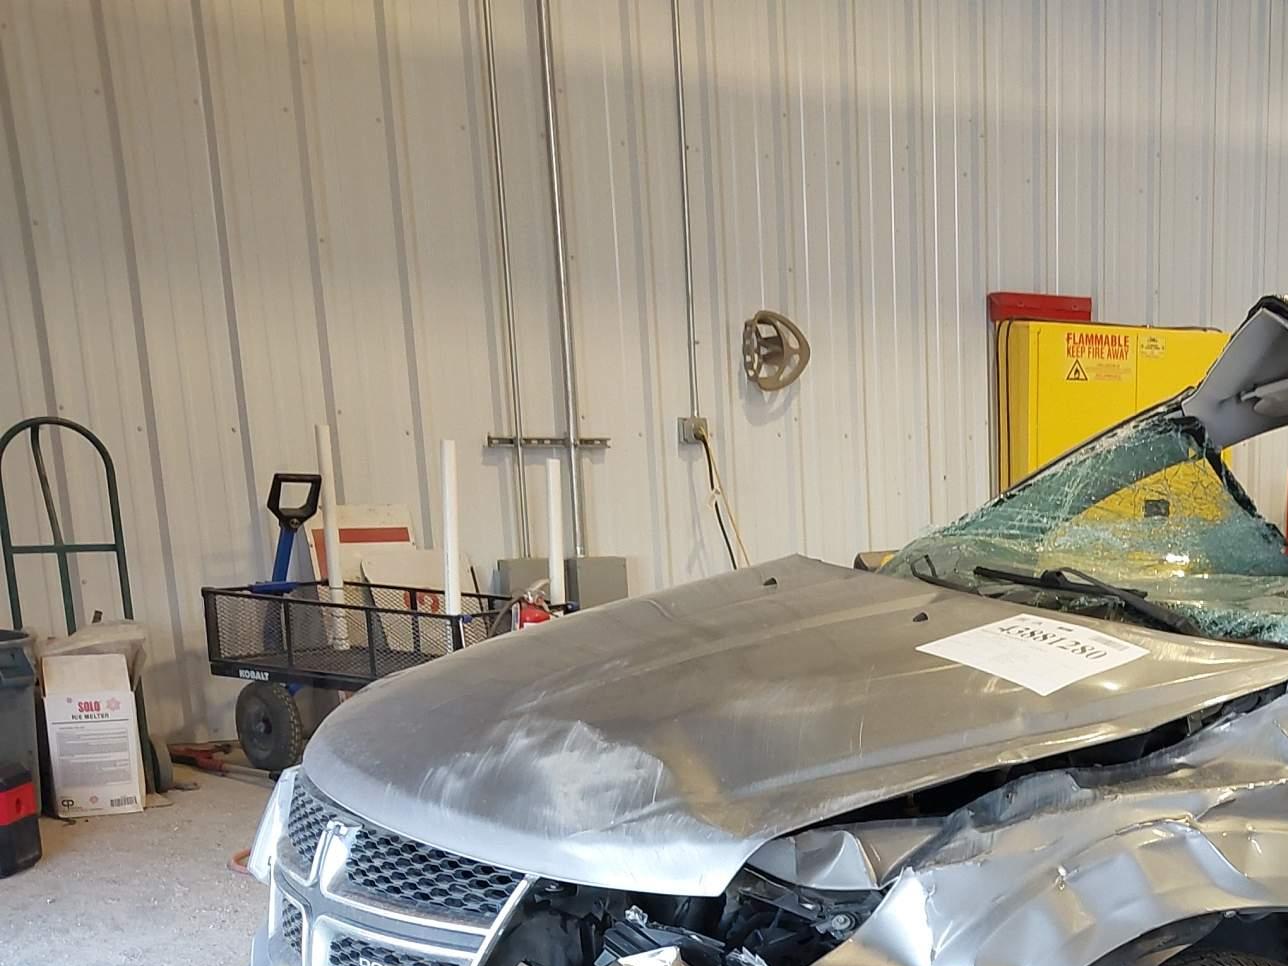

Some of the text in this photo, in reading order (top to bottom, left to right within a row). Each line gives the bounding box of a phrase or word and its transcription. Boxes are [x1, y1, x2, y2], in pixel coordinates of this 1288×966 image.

[1066, 332, 1130, 348] FLAMMABLE
[1066, 344, 1129, 361] KEEP FIRE AWAY
[998, 624, 1108, 660] 43881280
[239, 669, 269, 681] KOBALT
[78, 700, 101, 713] SOLO
[84, 712, 110, 720] MELTER
